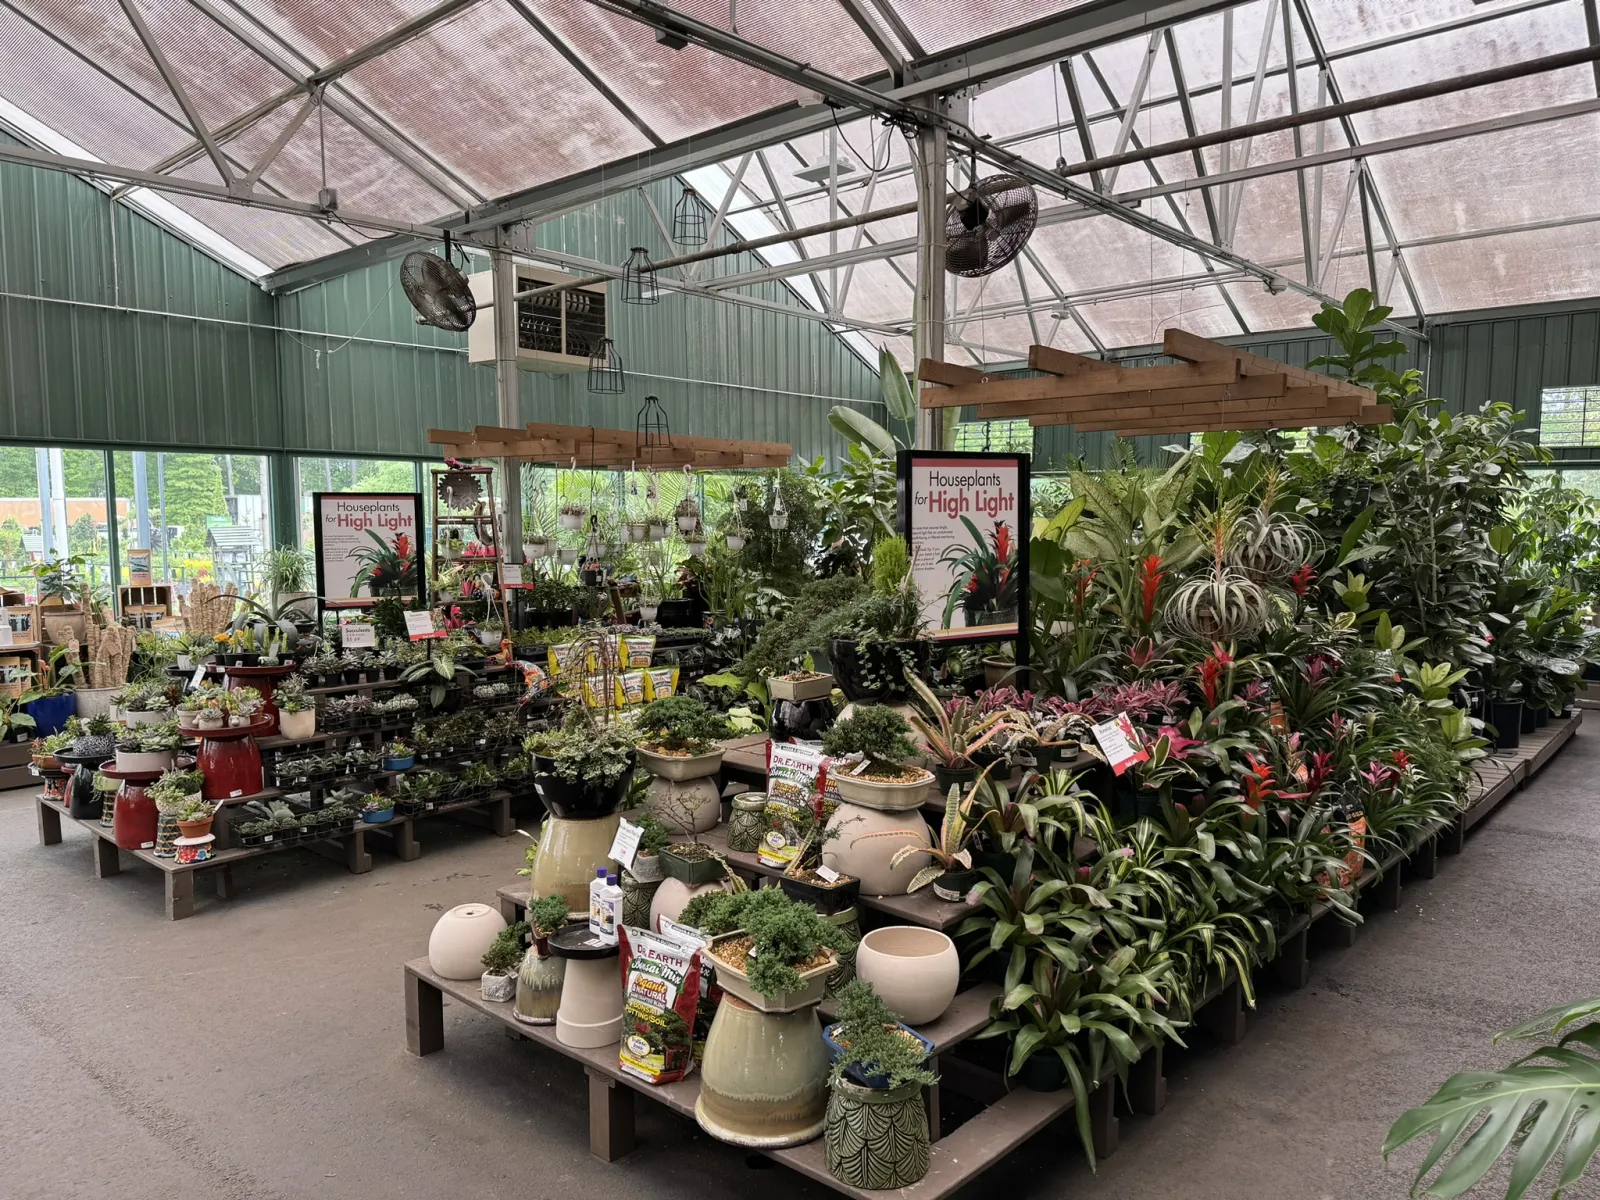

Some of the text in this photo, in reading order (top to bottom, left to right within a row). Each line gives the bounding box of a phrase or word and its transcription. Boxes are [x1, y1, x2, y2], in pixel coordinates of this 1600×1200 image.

[930, 470, 1000, 491] Houseplants
[337, 502, 400, 514] Houseplants
[915, 488, 1014, 519] for High Light
[326, 513, 412, 530] for High Light
[773, 755, 813, 772] DR. EARTH
[648, 949, 683, 968] EARTH
[631, 955, 682, 985] Bonsai Mix
[700, 963, 710, 977] ix
[635, 973, 667, 993] Organic
[636, 987, 667, 1004] NATURAL
[625, 1004, 668, 1028] POTTING SOIL
[633, 1000, 658, 1015] BONSAI
